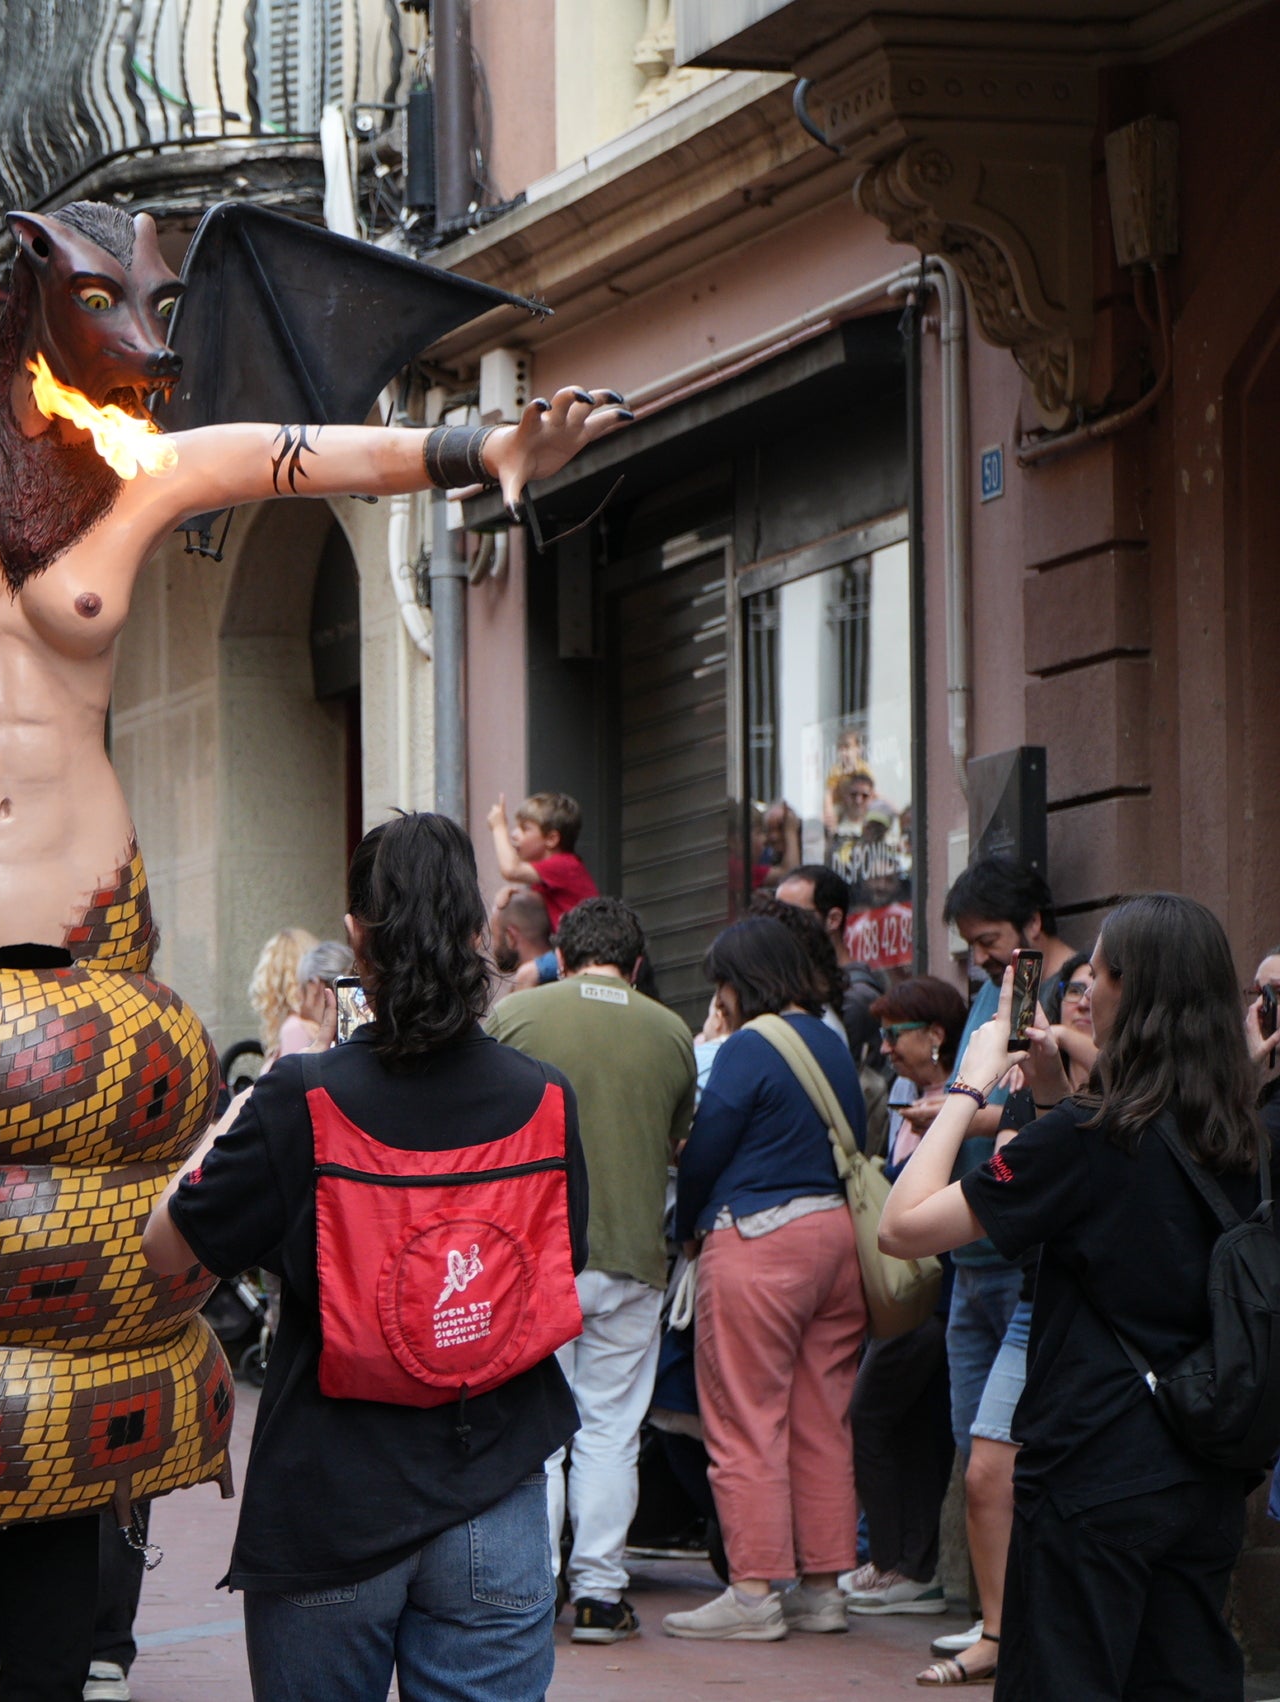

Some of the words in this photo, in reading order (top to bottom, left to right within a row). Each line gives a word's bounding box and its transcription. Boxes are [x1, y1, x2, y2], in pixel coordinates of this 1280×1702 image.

[983, 454, 998, 490] 50
[882, 916, 898, 957] 42
[433, 1307, 465, 1321] OPEN
